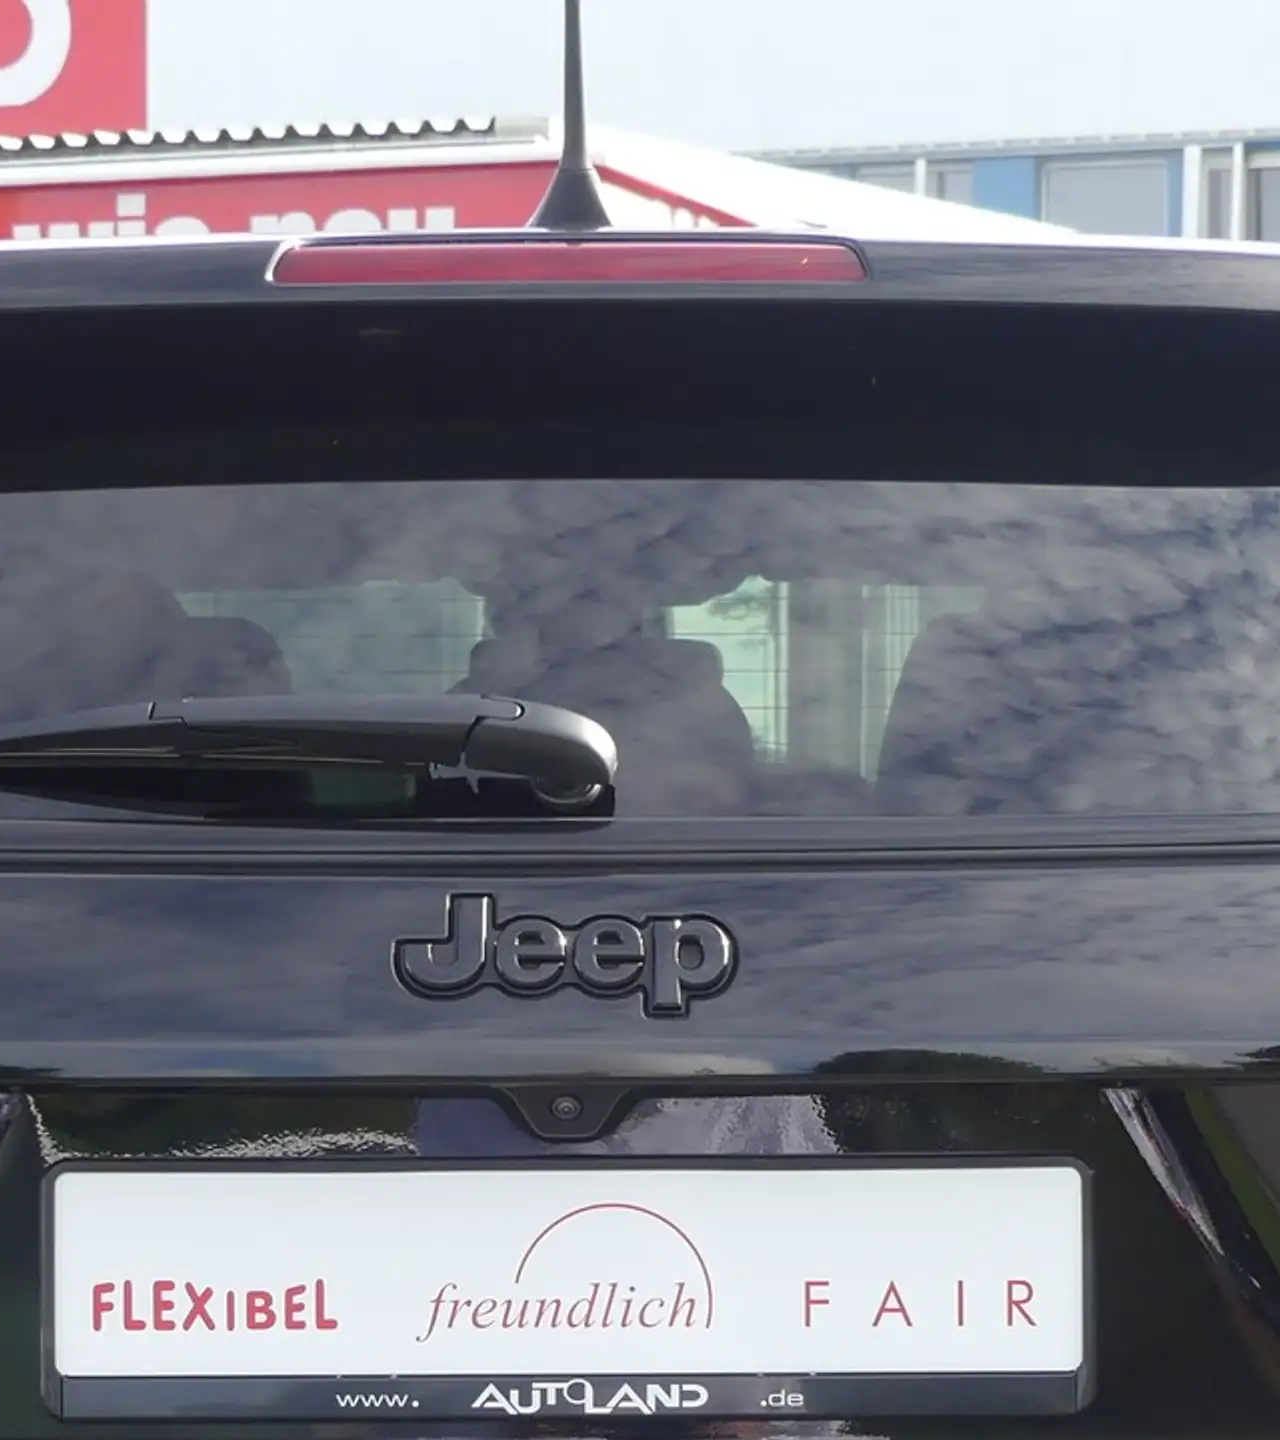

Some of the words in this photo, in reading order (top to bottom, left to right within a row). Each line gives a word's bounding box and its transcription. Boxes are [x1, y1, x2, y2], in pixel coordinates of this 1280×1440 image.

[391, 893, 740, 1019] Jeep
[91, 1278, 339, 1332] FLEXIBEL
[416, 1282, 697, 1343] freundlich
[803, 1279, 1038, 1328] FAIR
[335, 1392, 420, 1409] www.
[471, 1378, 709, 1416] AUTOLAND
[760, 1388, 805, 1408] .de
